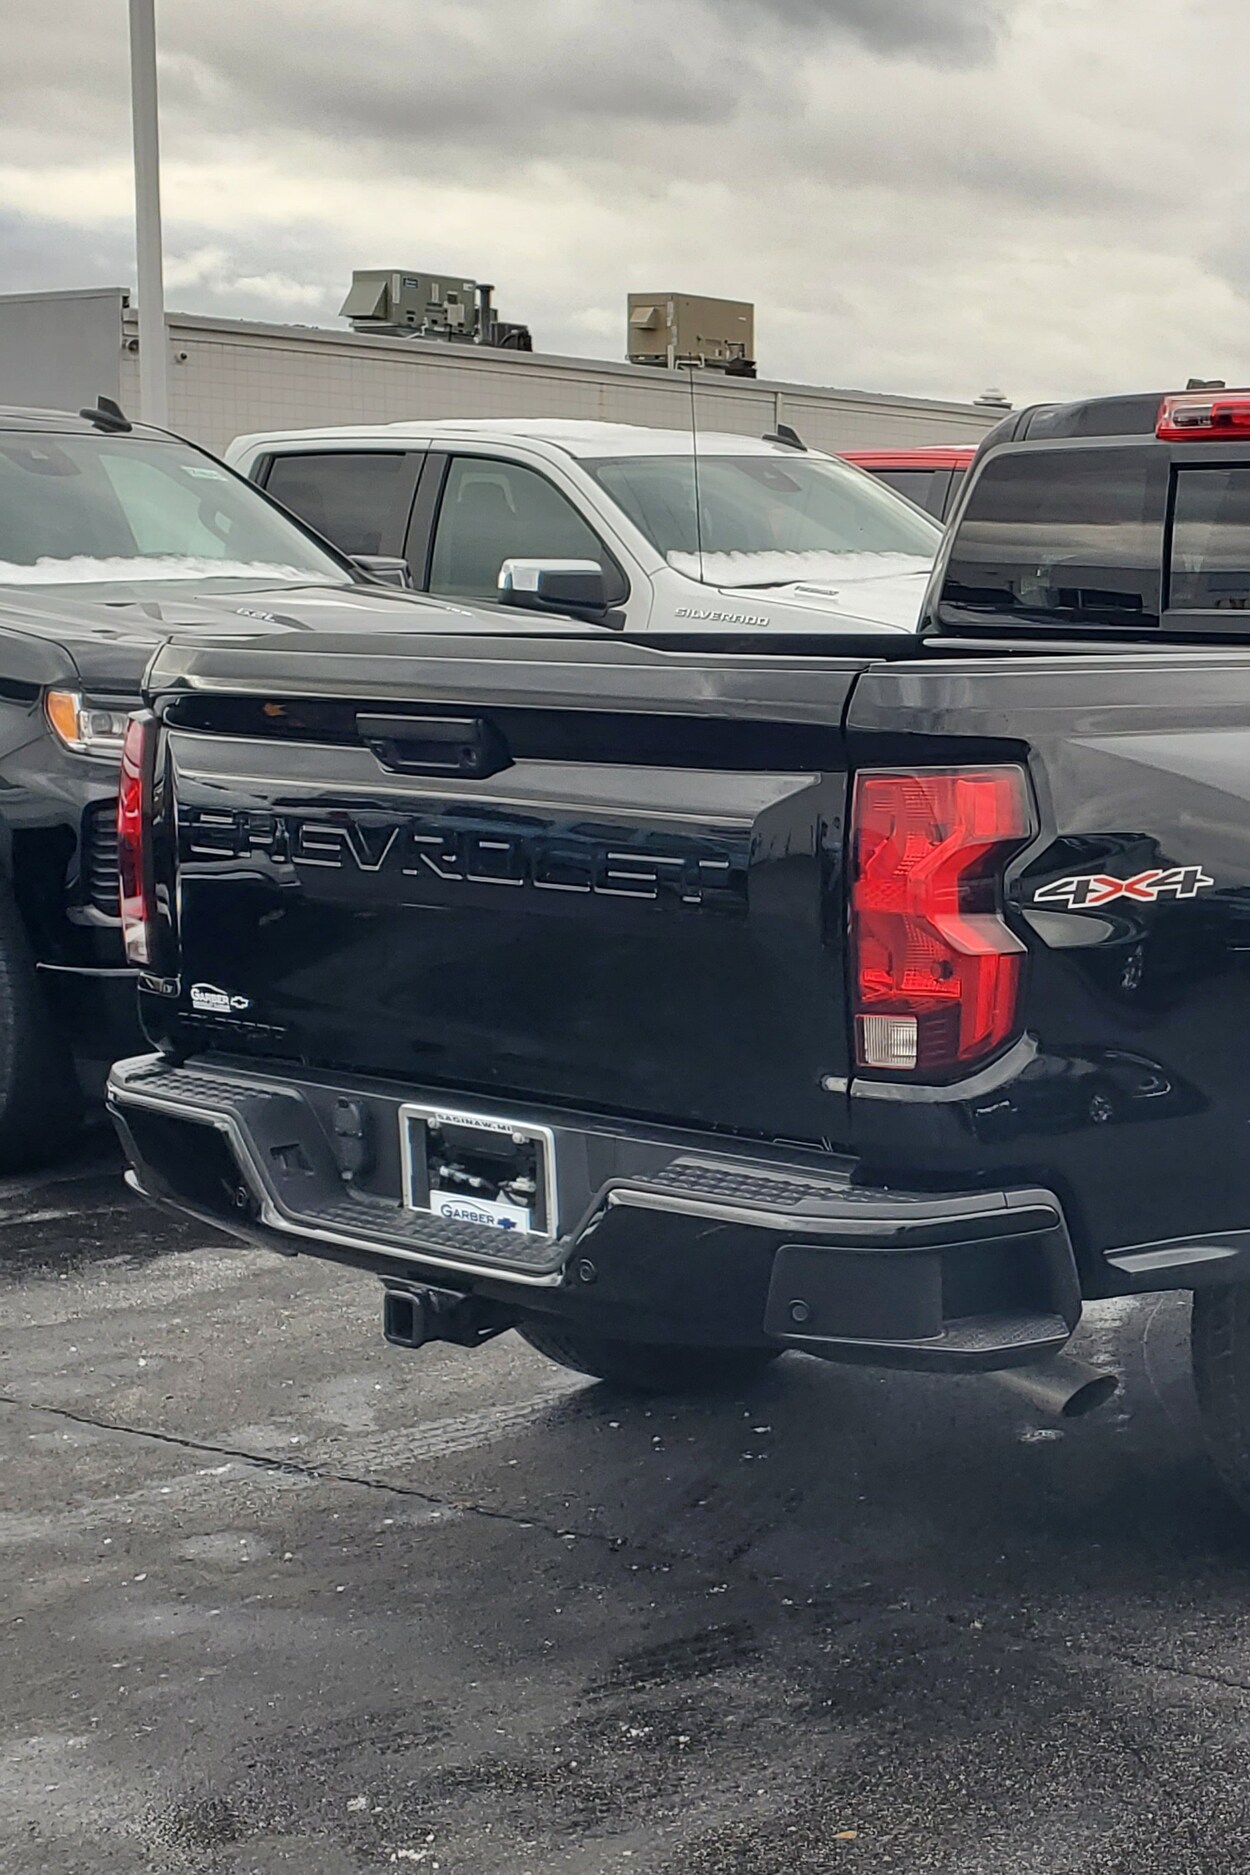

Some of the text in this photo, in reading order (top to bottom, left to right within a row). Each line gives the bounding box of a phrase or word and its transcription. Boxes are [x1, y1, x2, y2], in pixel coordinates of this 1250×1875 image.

[675, 608, 770, 627] SILVERADO
[188, 812, 731, 904] CHEVROLET
[440, 1203, 495, 1225] GARBER
